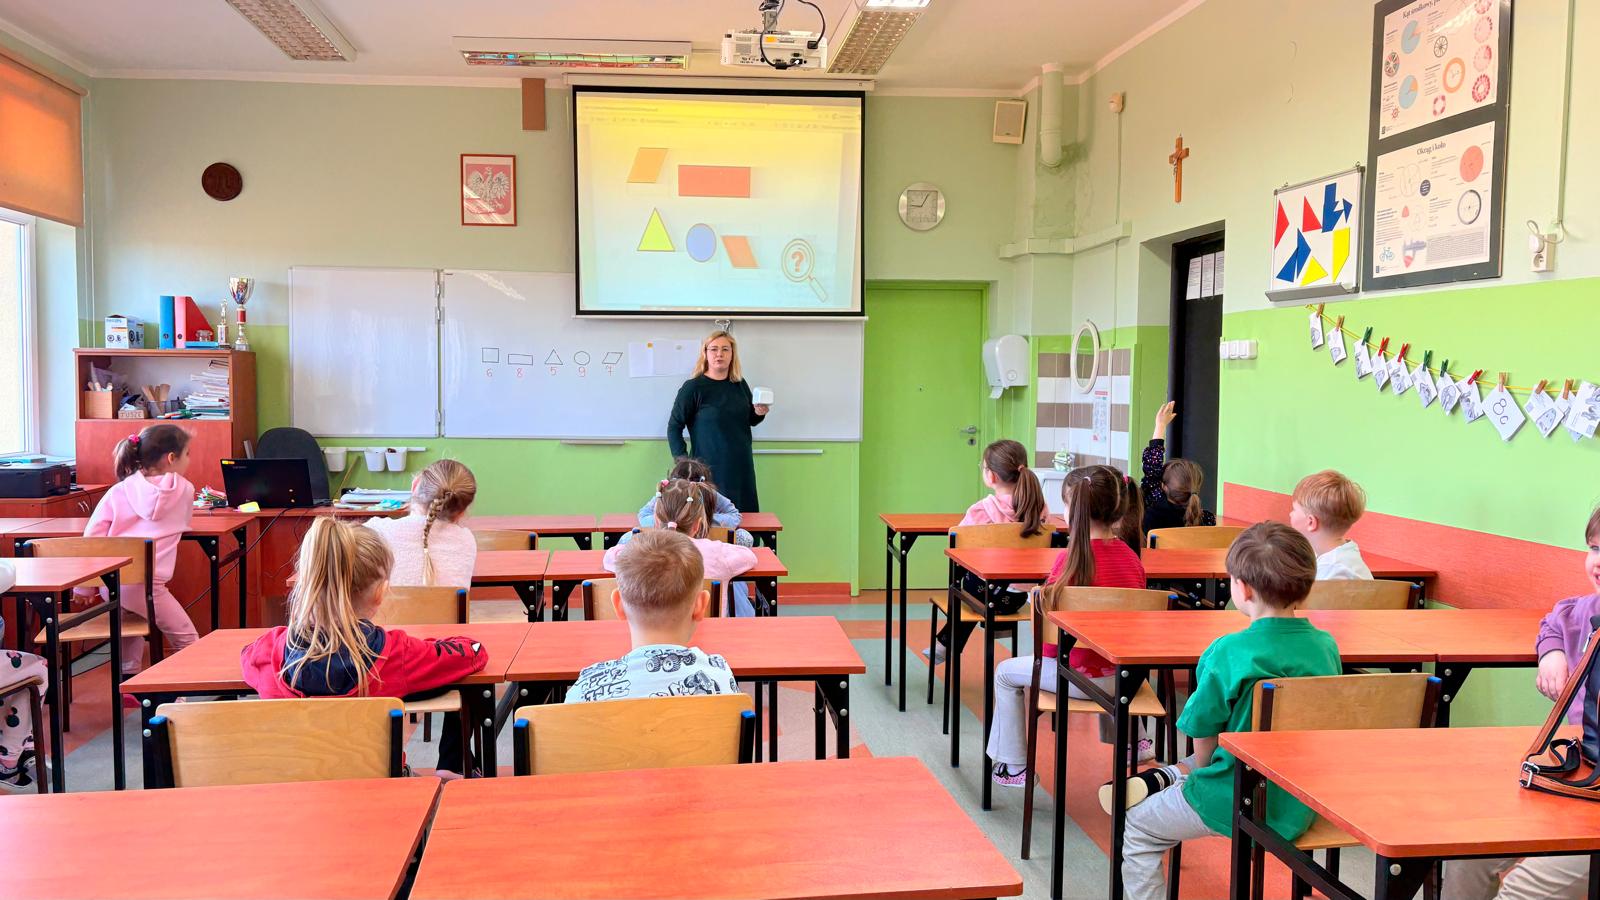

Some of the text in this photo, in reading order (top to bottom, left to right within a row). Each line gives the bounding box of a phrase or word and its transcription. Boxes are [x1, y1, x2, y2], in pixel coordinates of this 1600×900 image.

[486, 365, 614, 378] 6 8 5 9 7
